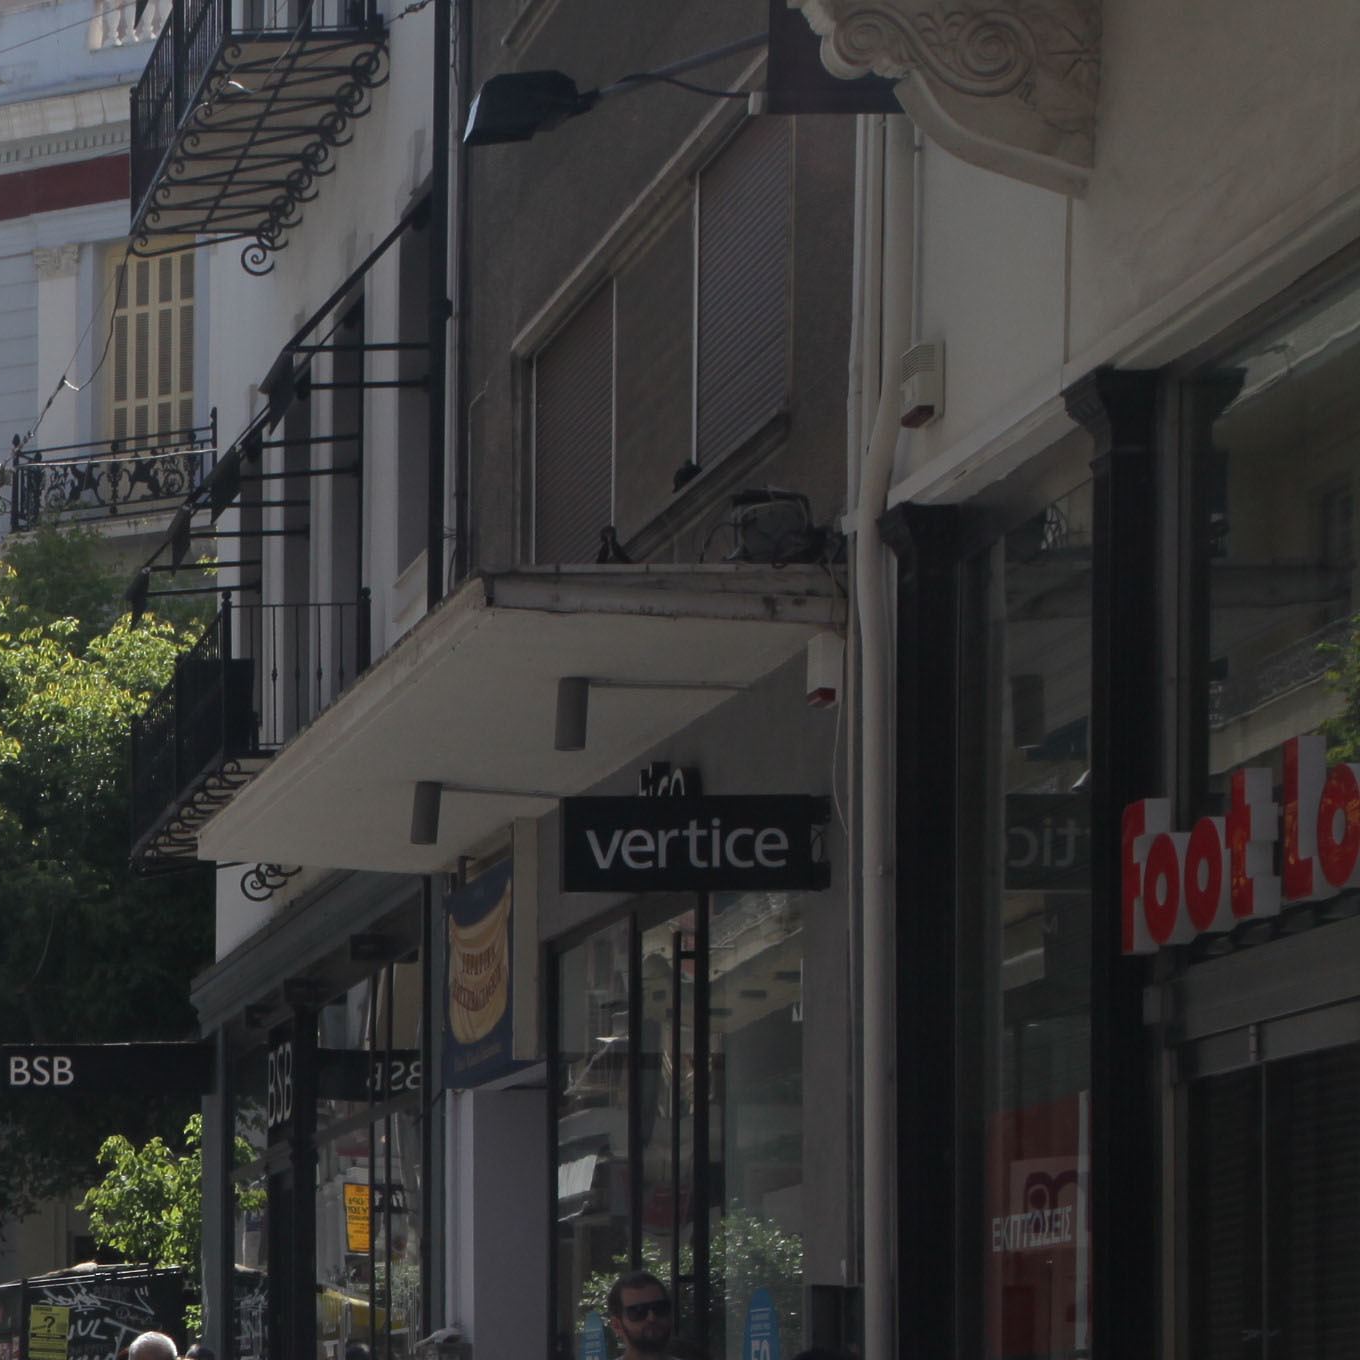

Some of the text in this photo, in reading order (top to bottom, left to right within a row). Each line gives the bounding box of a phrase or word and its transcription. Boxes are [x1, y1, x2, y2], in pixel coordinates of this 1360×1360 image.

[585, 817, 788, 869] vertice
[1122, 768, 1262, 955] foot
[9, 1056, 74, 1086] BSB
[267, 1041, 294, 1129] BSB
[991, 1204, 1073, 1253] ΕΚΠΤΩΣΕΙΣ
